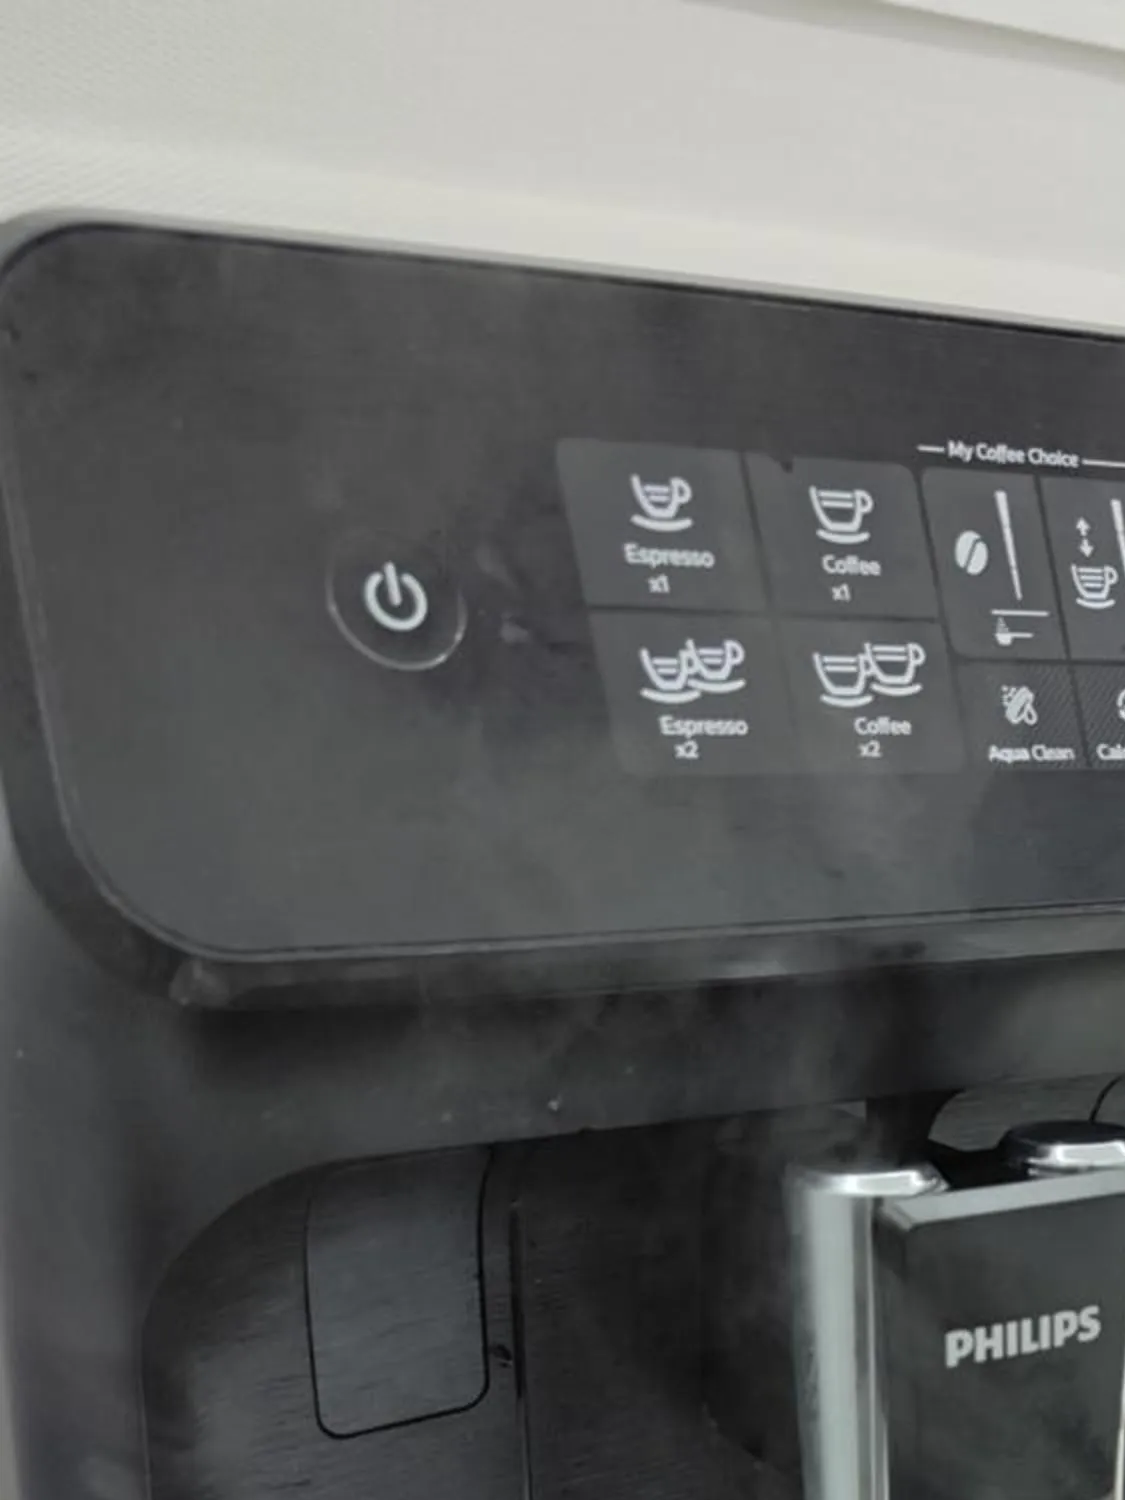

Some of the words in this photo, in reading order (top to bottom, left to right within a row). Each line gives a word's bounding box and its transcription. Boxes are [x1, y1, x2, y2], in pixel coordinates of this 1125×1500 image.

[948, 439, 973, 462] My
[975, 441, 1025, 464] Coffee
[1027, 447, 1080, 468] Choice
[623, 542, 716, 569] Espresso
[822, 553, 882, 576] Coffee
[648, 574, 670, 594] x1
[831, 582, 852, 602] x1
[659, 714, 749, 739] Espresso
[854, 716, 912, 736] Coffee
[674, 740, 699, 760] x2
[858, 740, 883, 758] x2
[989, 744, 1030, 763] Aqua
[1031, 744, 1076, 761] Clean
[945, 1305, 1102, 1368] PHILIPS
